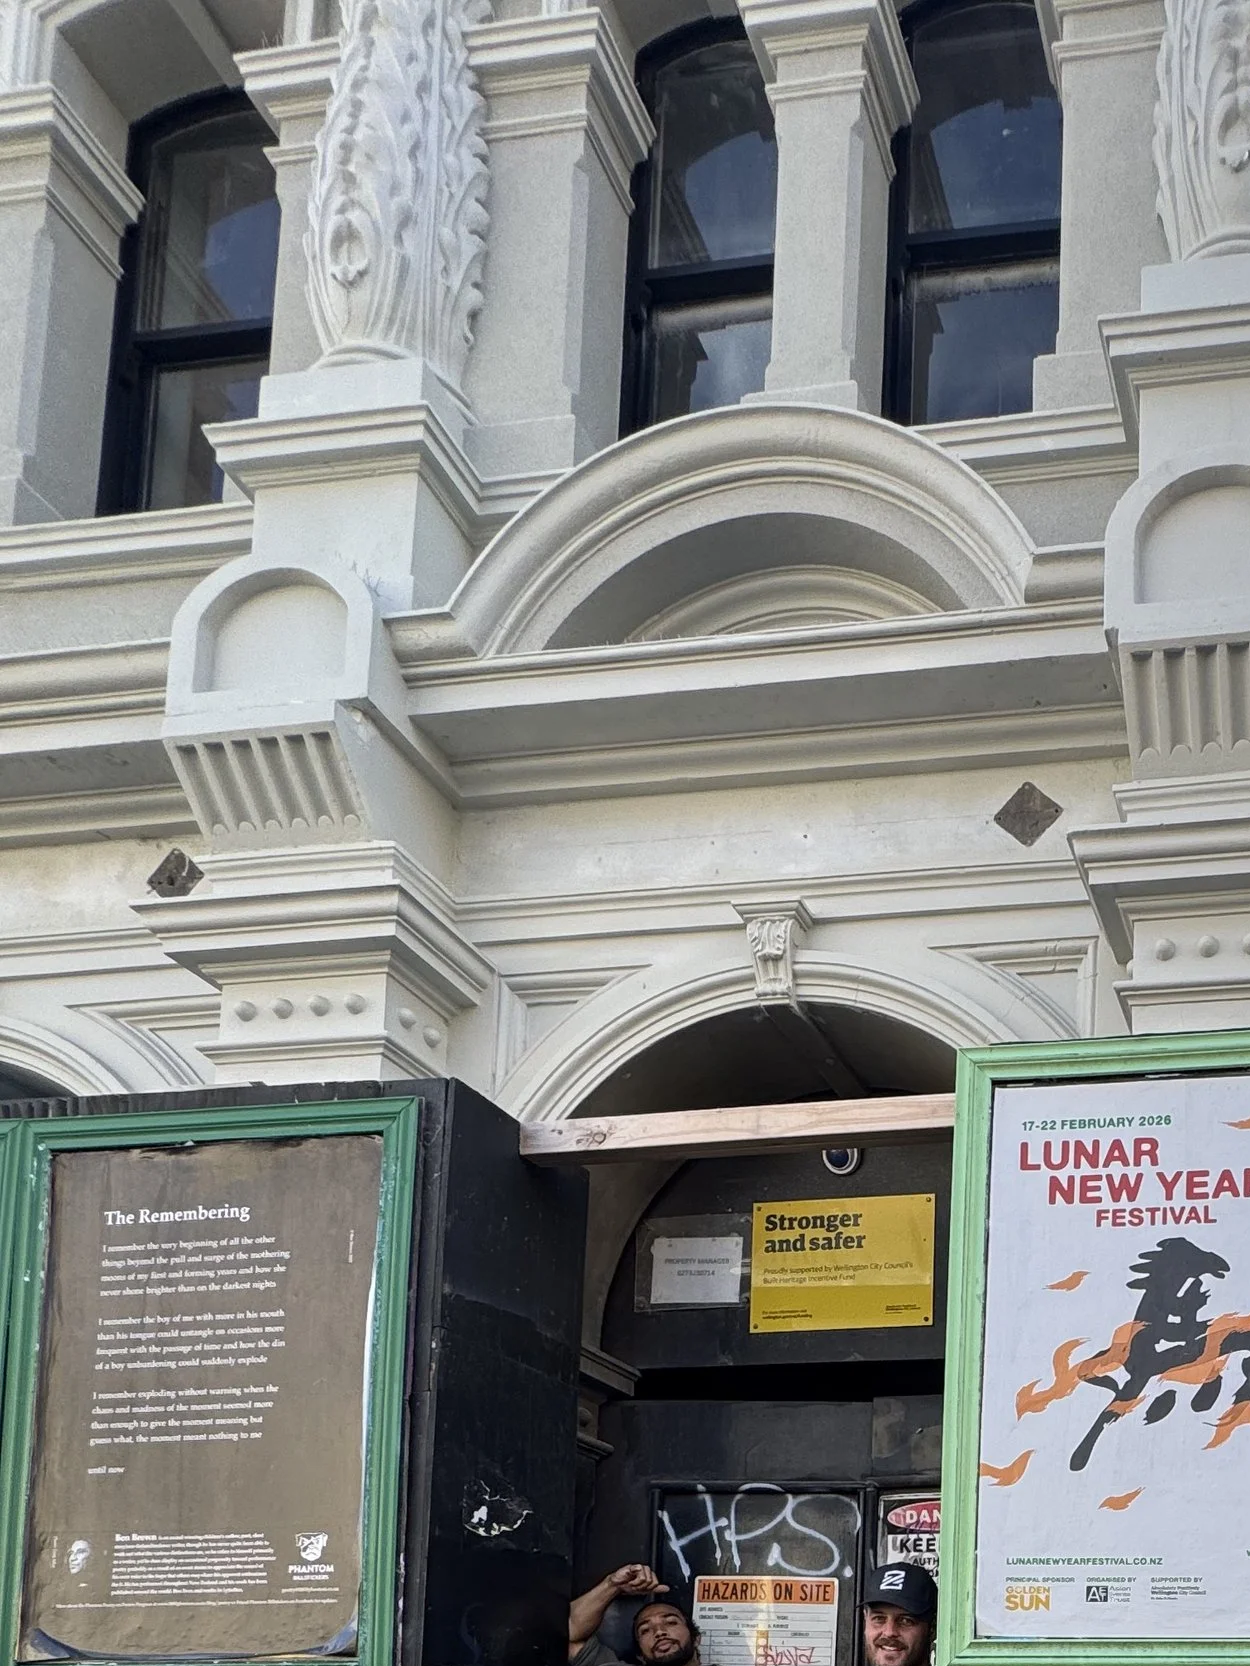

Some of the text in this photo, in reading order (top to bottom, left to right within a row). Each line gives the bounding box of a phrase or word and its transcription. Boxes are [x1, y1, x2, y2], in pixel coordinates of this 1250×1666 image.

[1021, 1114, 1171, 1131] 17-22 FEBRUARY 2026
[1020, 1137, 1159, 1171] LUNAR
[1049, 1173, 1143, 1205] NEW
[104, 1204, 250, 1226] The Remembering
[765, 1213, 862, 1232] Stronger
[1096, 1205, 1217, 1227] FESTIVAL
[764, 1232, 866, 1253] and safer
[790, 1265, 823, 1274] supported
[834, 1264, 868, 1272] Wellington
[884, 1261, 913, 1269] Council's
[906, 1509, 941, 1523] DAN
[900, 1538, 936, 1553] KEE
[288, 1564, 334, 1573] PHANTOM
[702, 1582, 830, 1601] HAZARDS ON SITE
[1005, 1586, 1050, 1594] GOLDEN
[1005, 1595, 1050, 1611] SUN
